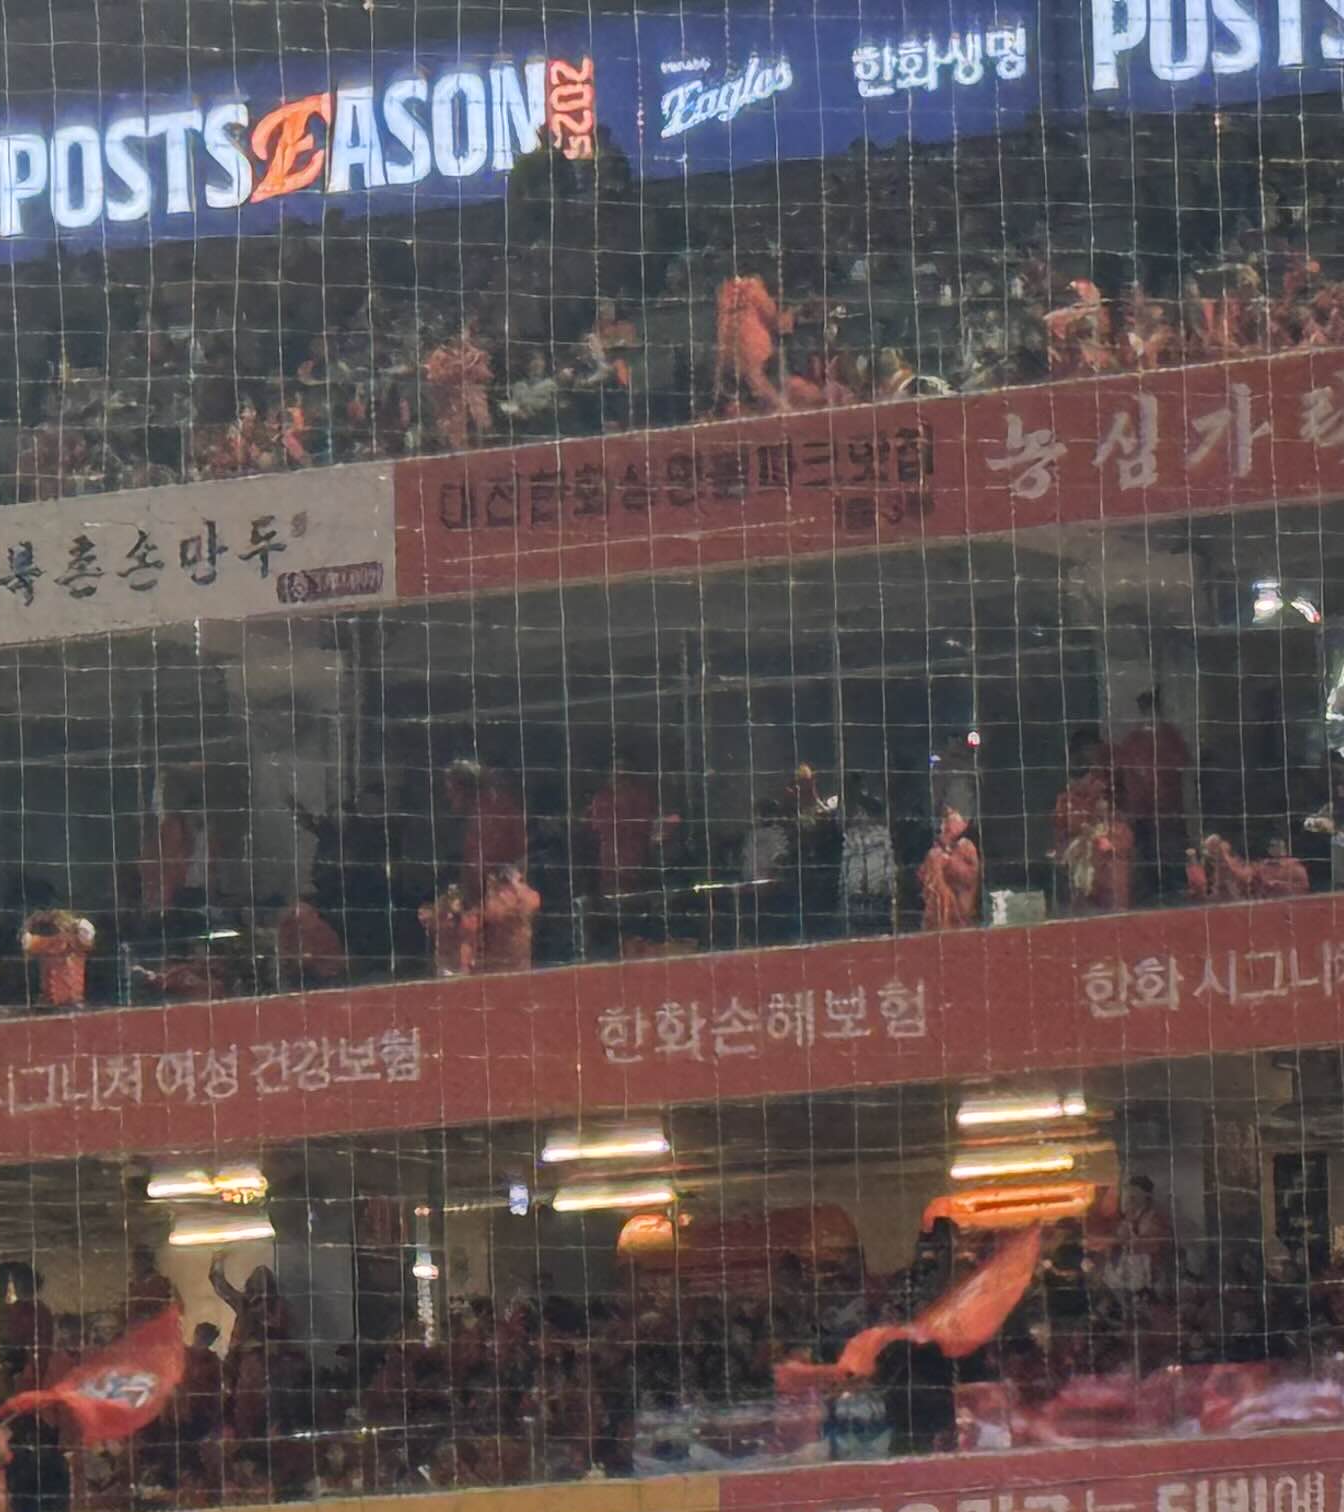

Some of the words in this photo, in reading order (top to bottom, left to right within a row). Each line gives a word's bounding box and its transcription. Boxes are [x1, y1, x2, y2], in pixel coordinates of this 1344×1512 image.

[661, 54, 793, 138] Eagles
[853, 26, 1027, 97] 한화생명
[597, 979, 929, 1067] 한화손해보험
[1081, 956, 1182, 1018] 한화
[156, 1044, 239, 1101] 여성
[250, 1027, 422, 1095] 건강보험
